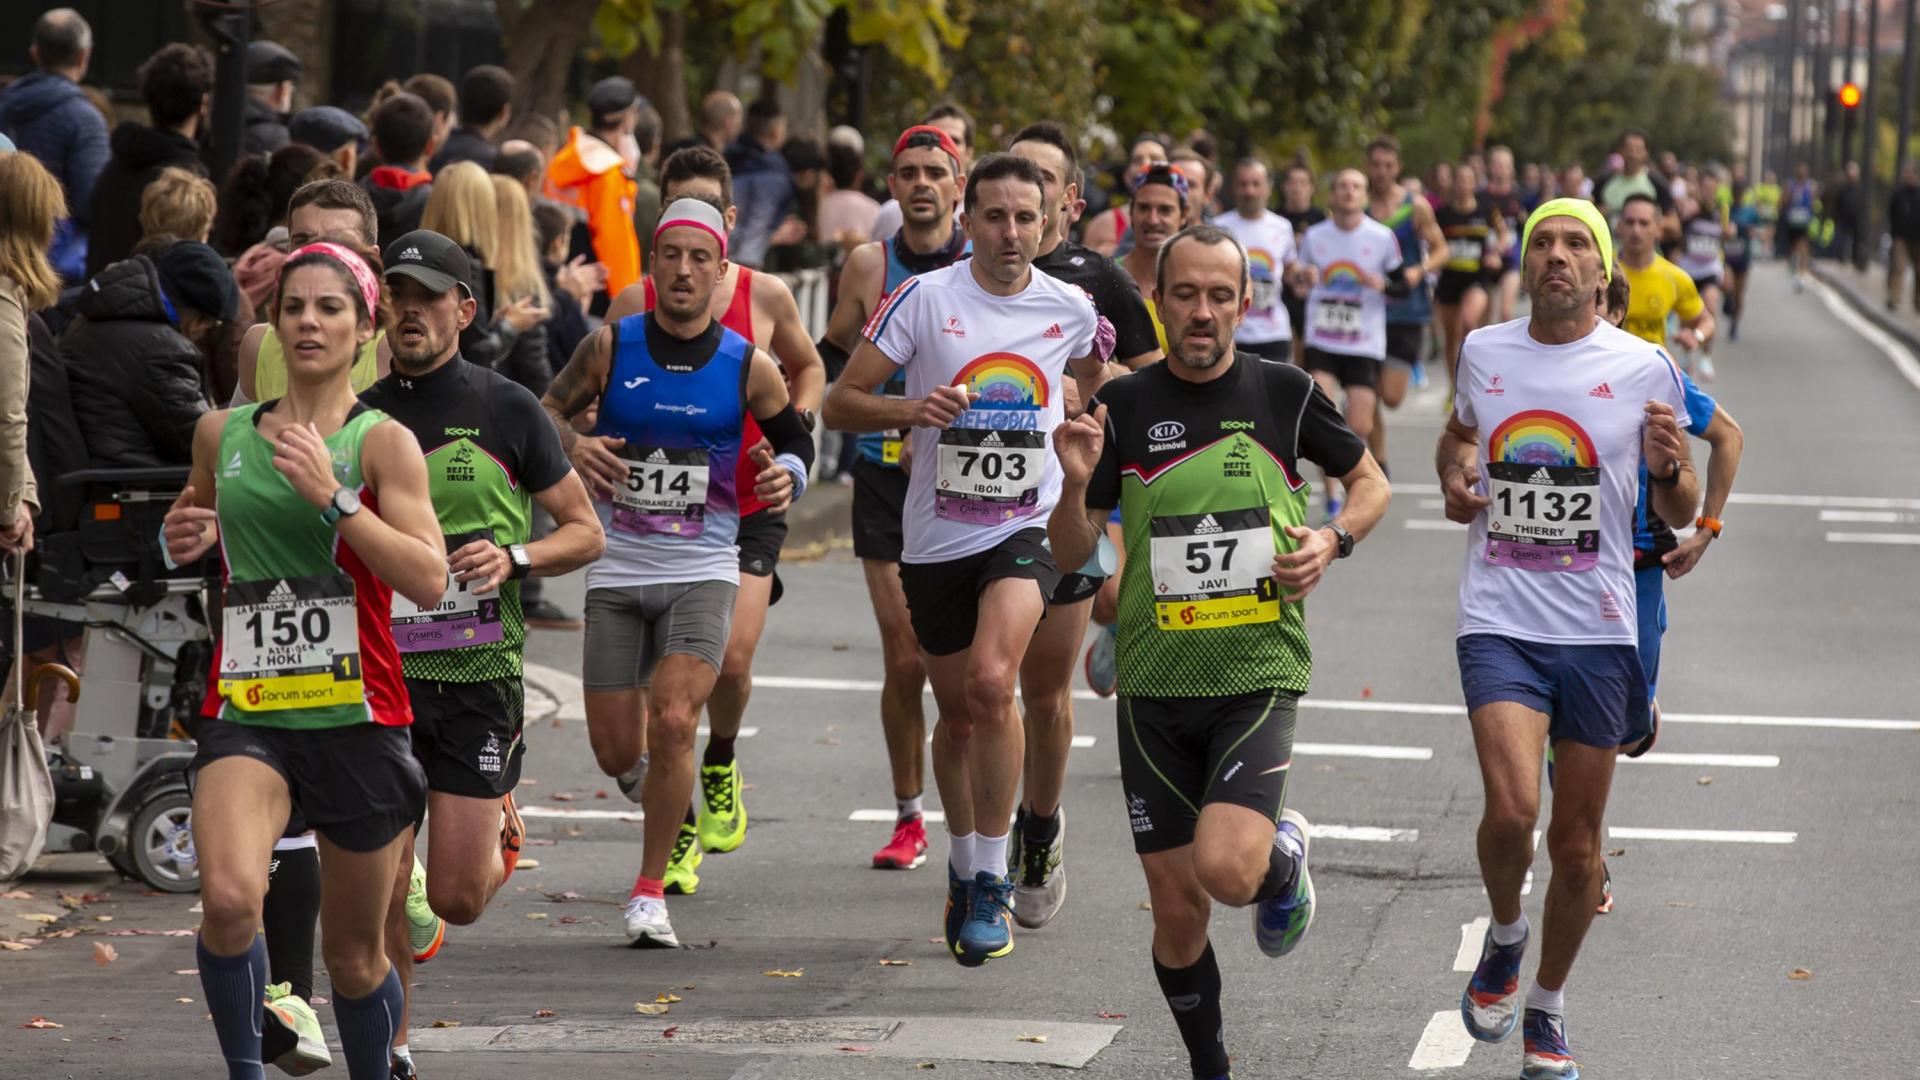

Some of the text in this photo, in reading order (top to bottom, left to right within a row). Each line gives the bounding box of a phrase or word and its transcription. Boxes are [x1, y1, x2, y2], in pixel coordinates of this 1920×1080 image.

[1154, 424, 1179, 438] KIA
[1149, 440, 1187, 453] Sakimóvil
[957, 451, 1027, 480] 703
[627, 466, 691, 496] 514
[1528, 477, 1554, 485] adidas
[1025, 491, 1034, 502] 2
[1497, 487, 1593, 522] 1132
[1194, 526, 1223, 534] adidas
[1514, 524, 1565, 537] THIERRY
[1584, 534, 1593, 549] 2
[1186, 538, 1239, 574] 57
[1198, 578, 1228, 590] JAVI
[1263, 580, 1271, 597] 1
[267, 594, 297, 603] adidas
[417, 600, 457, 613] DVID
[484, 602, 495, 619] 2
[1195, 606, 1258, 622] forum sport
[246, 607, 331, 649] 150
[407, 629, 443, 642] CAMPOS
[267, 655, 302, 666] HOKI
[341, 656, 351, 676] 1
[262, 688, 334, 702] forum sport
